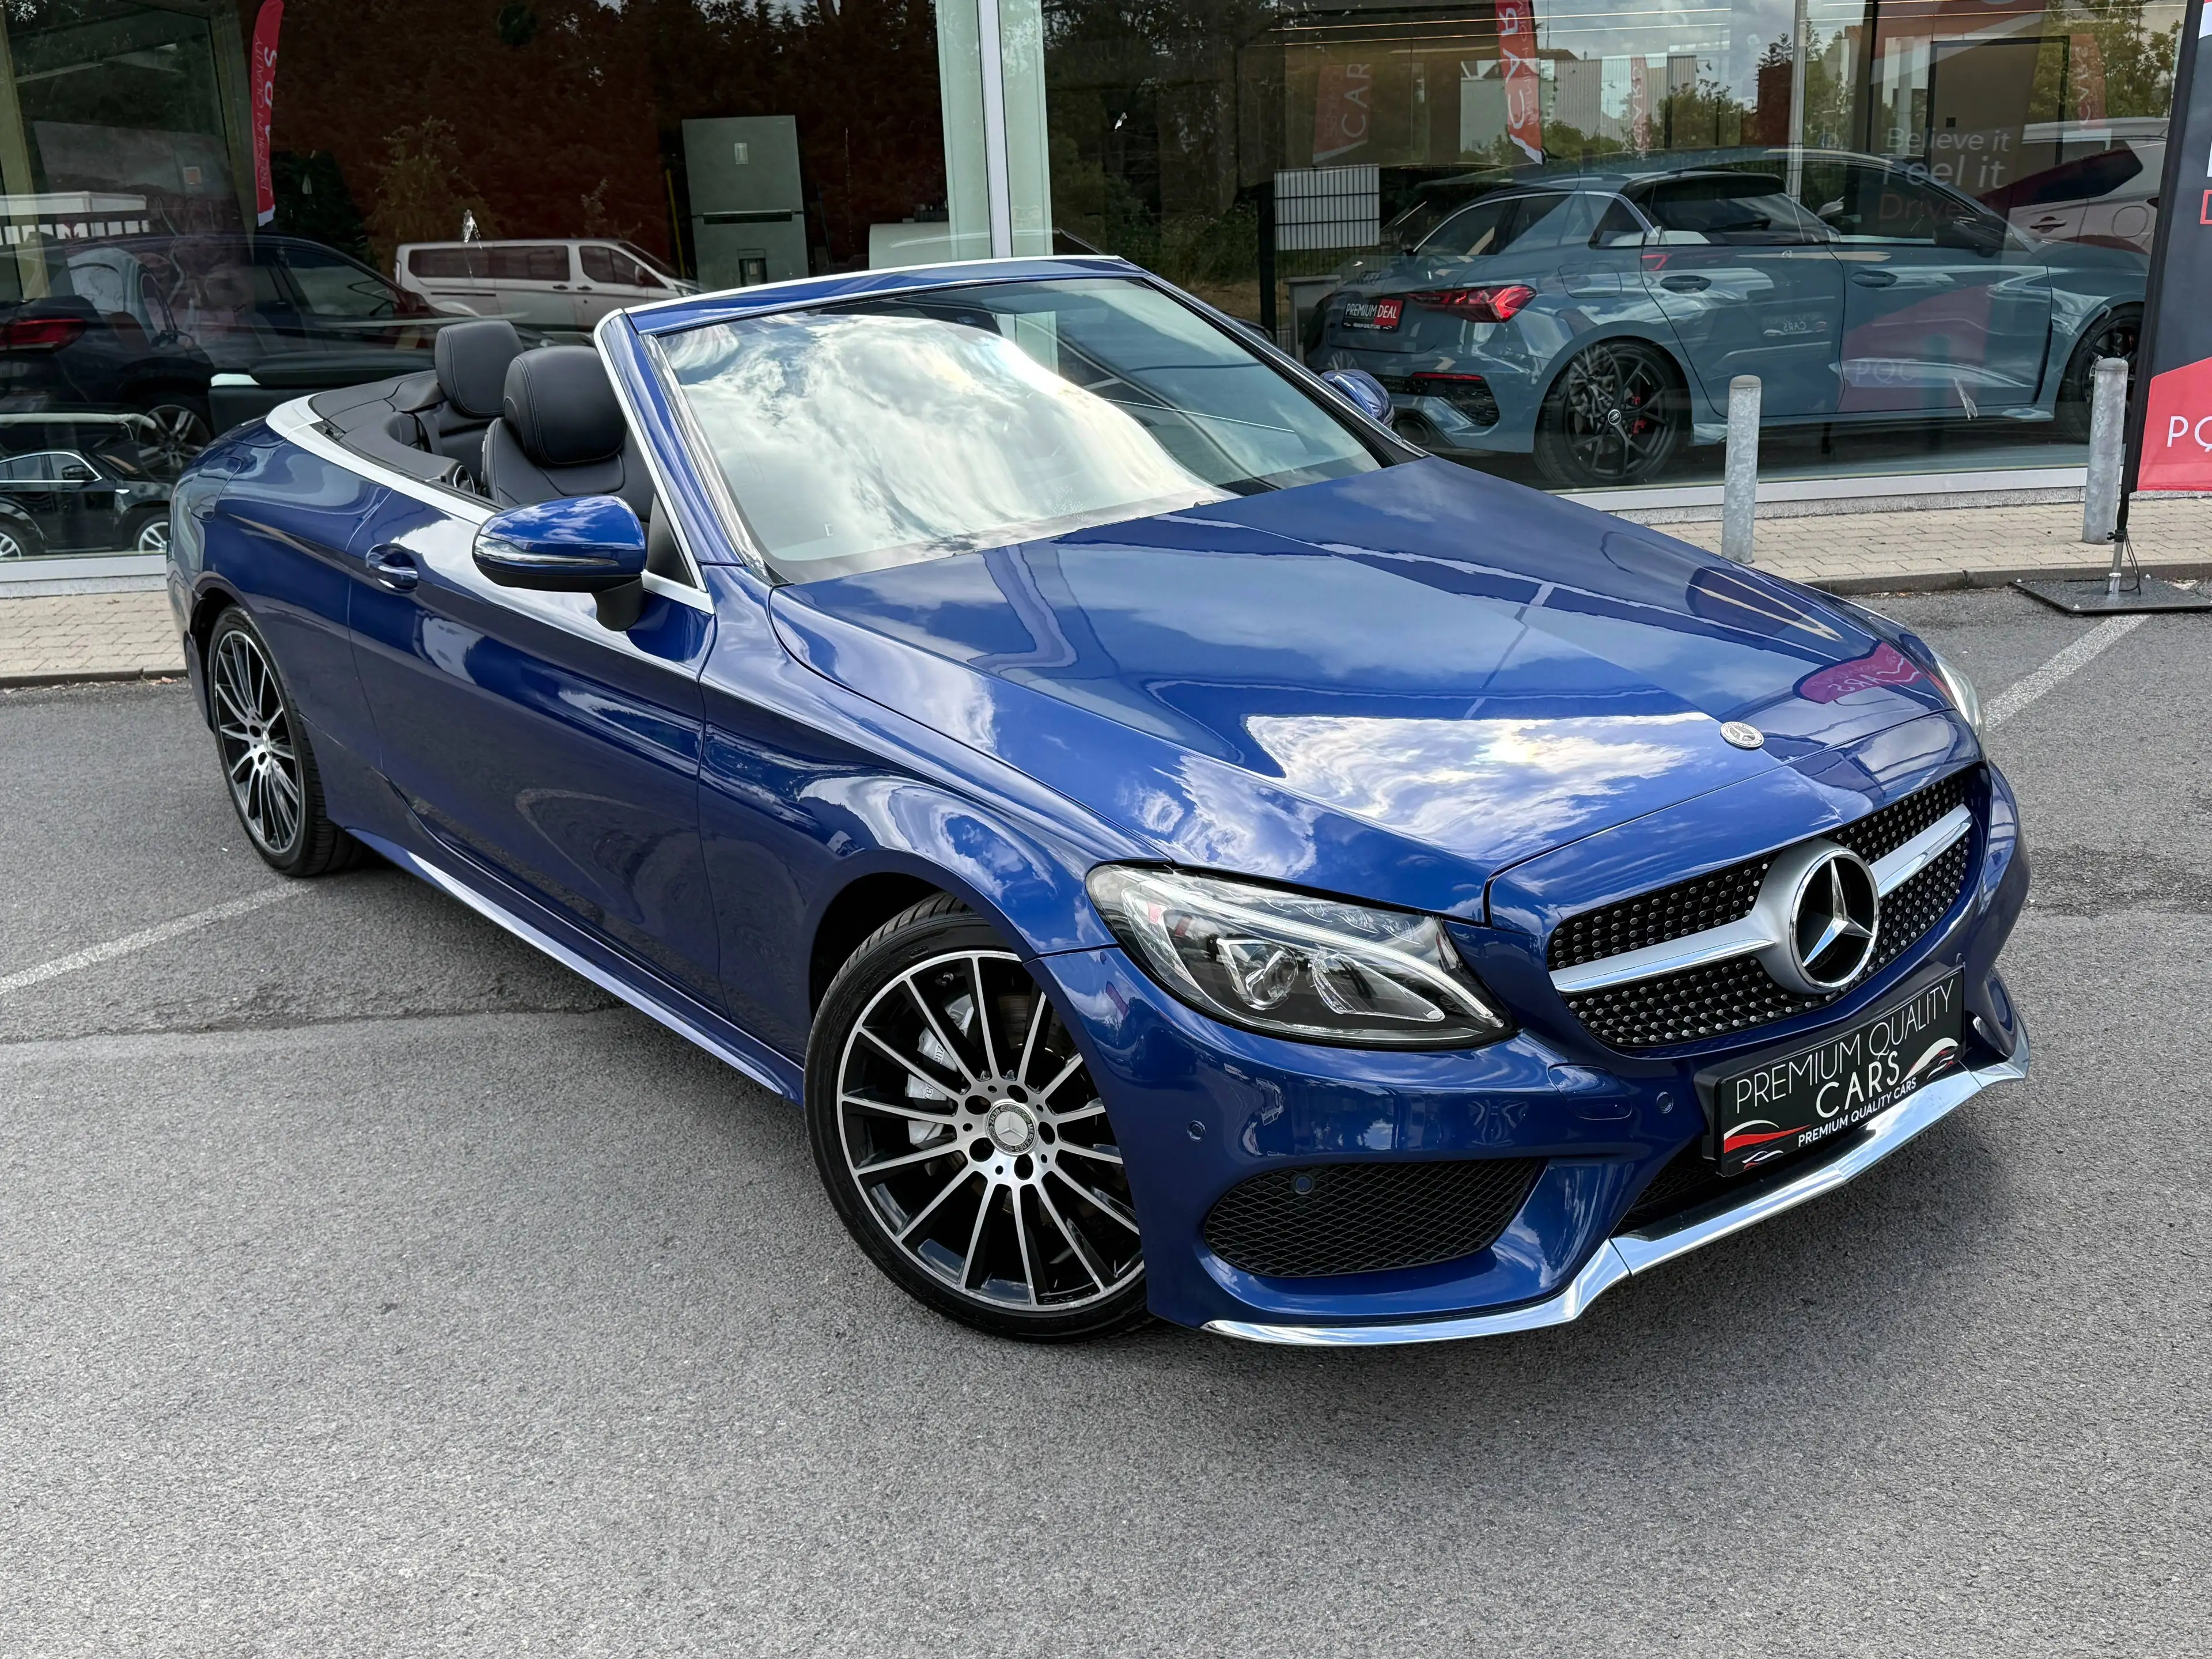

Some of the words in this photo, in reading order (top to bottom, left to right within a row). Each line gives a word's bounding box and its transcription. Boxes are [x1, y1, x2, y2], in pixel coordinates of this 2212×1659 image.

[1341, 63, 1371, 138] CAR
[1887, 127, 1984, 151] Believe
[1993, 130, 2010, 152] it
[1979, 156, 2006, 189] it
[1345, 303, 1378, 317] PREMIUM
[1377, 305, 1397, 319] DEAL
[1736, 1033, 1861, 1113] PREMIUM
[1869, 979, 1954, 1060] QUALITY
[1816, 1051, 1900, 1119] CARS
[989, 1109, 1001, 1125] BENZ
[1798, 1114, 1849, 1147] PREMIUM
[1851, 1092, 1892, 1121] QUALITY
[1893, 1077, 1916, 1097] CARS
[1014, 1123, 1035, 1152] MERCEDES
